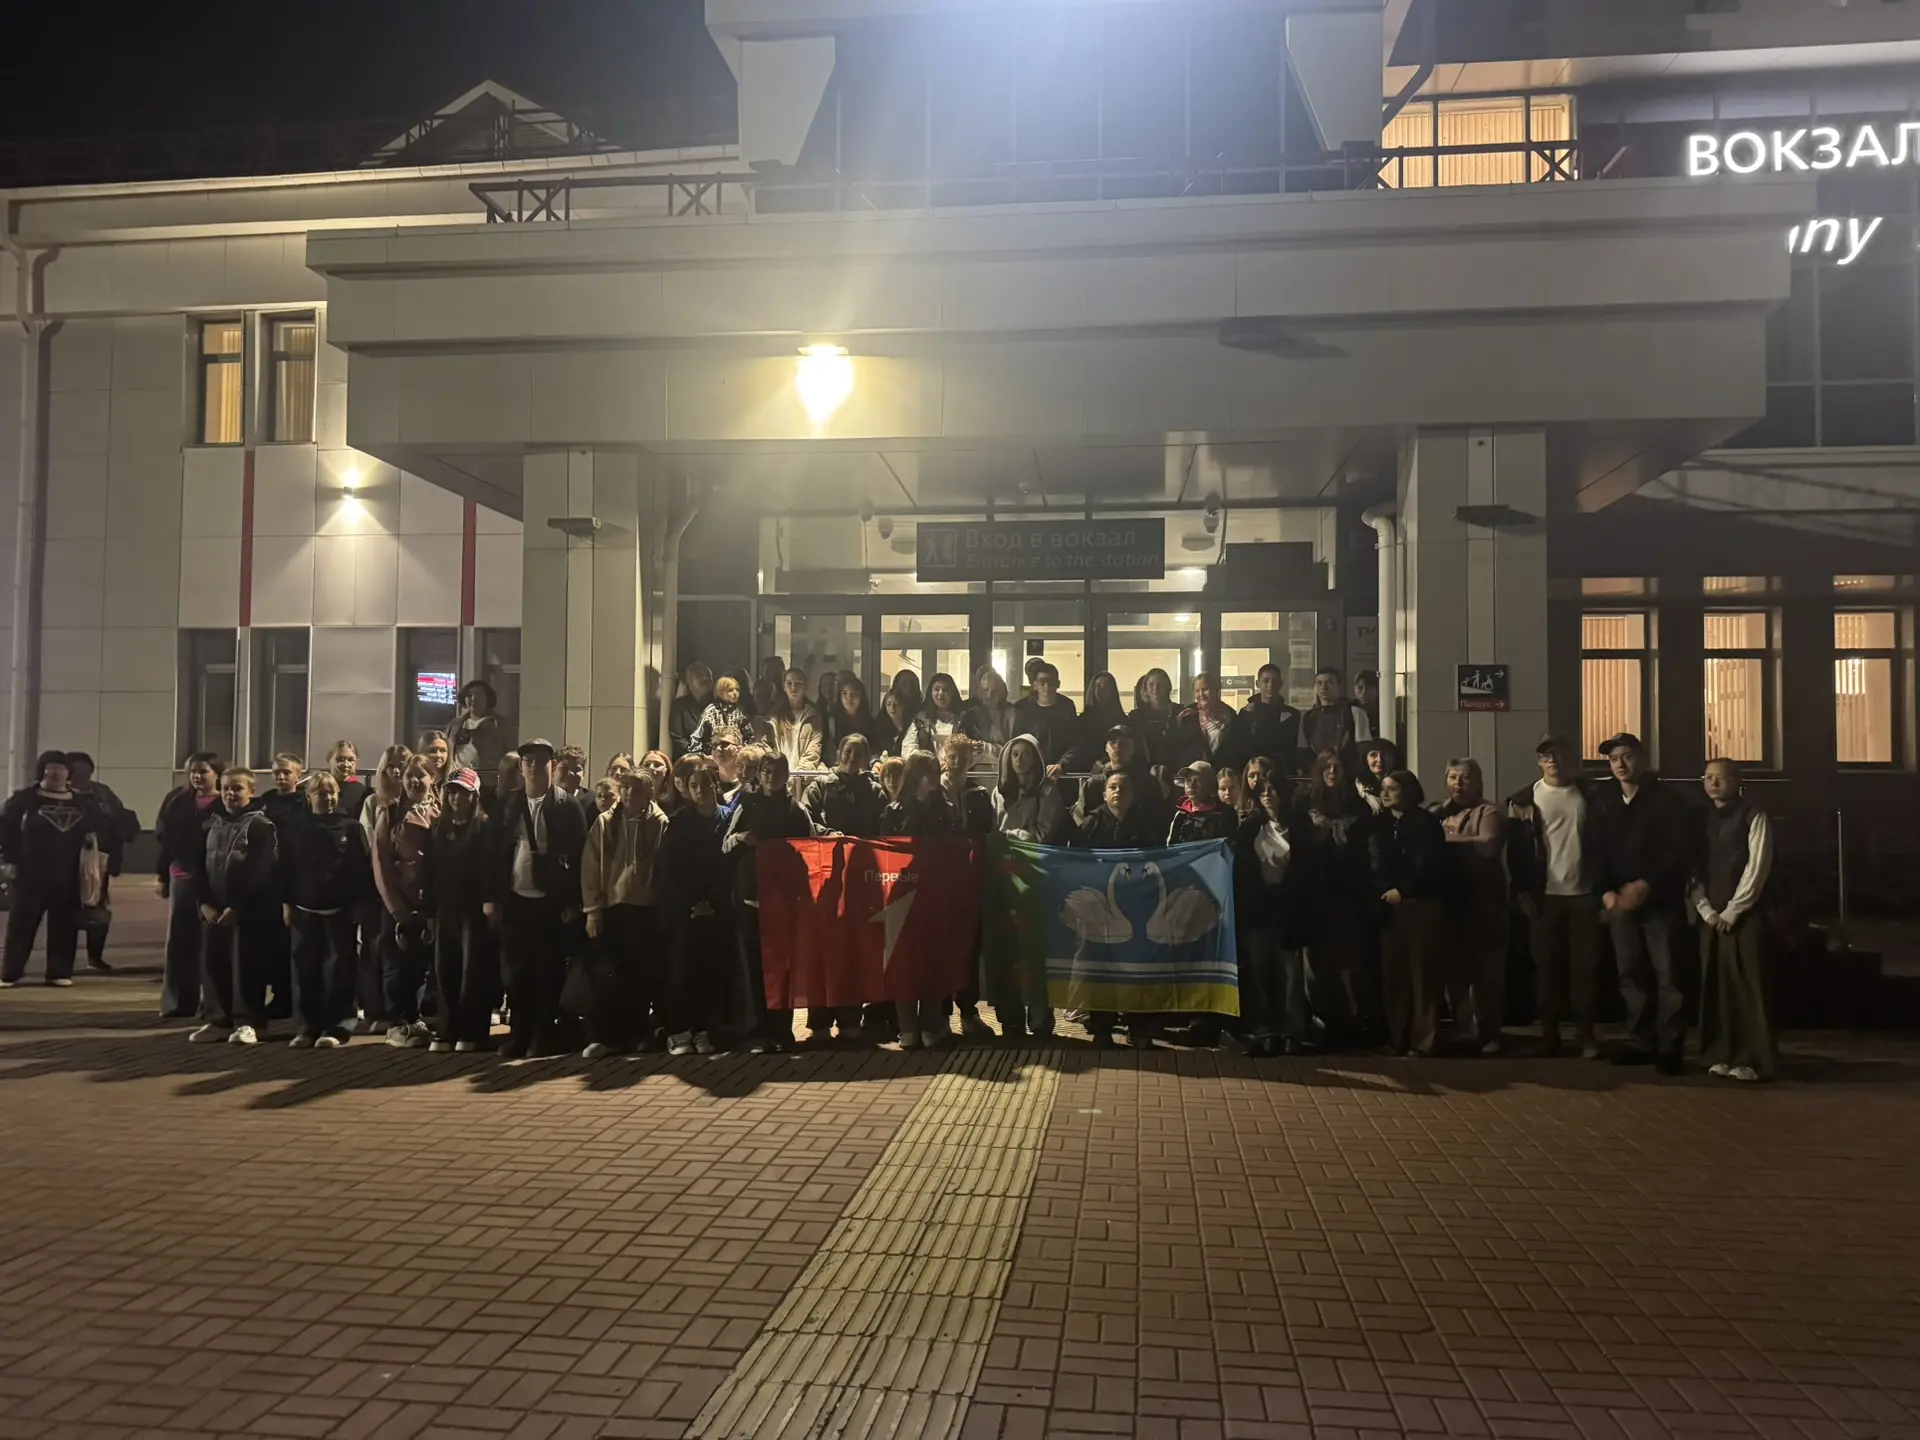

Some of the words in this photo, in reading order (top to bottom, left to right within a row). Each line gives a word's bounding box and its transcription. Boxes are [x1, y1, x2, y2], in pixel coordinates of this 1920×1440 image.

[1688, 122, 1920, 177] ВОКЗАЛ
[966, 529, 1023, 550] Вход
[1031, 533, 1042, 547] в
[1051, 530, 1136, 548] вокзал
[966, 555, 1040, 569] Entrance
[1044, 554, 1061, 567] to
[1067, 553, 1092, 567] the
[1099, 552, 1159, 565] station
[864, 870, 919, 886] Первые
